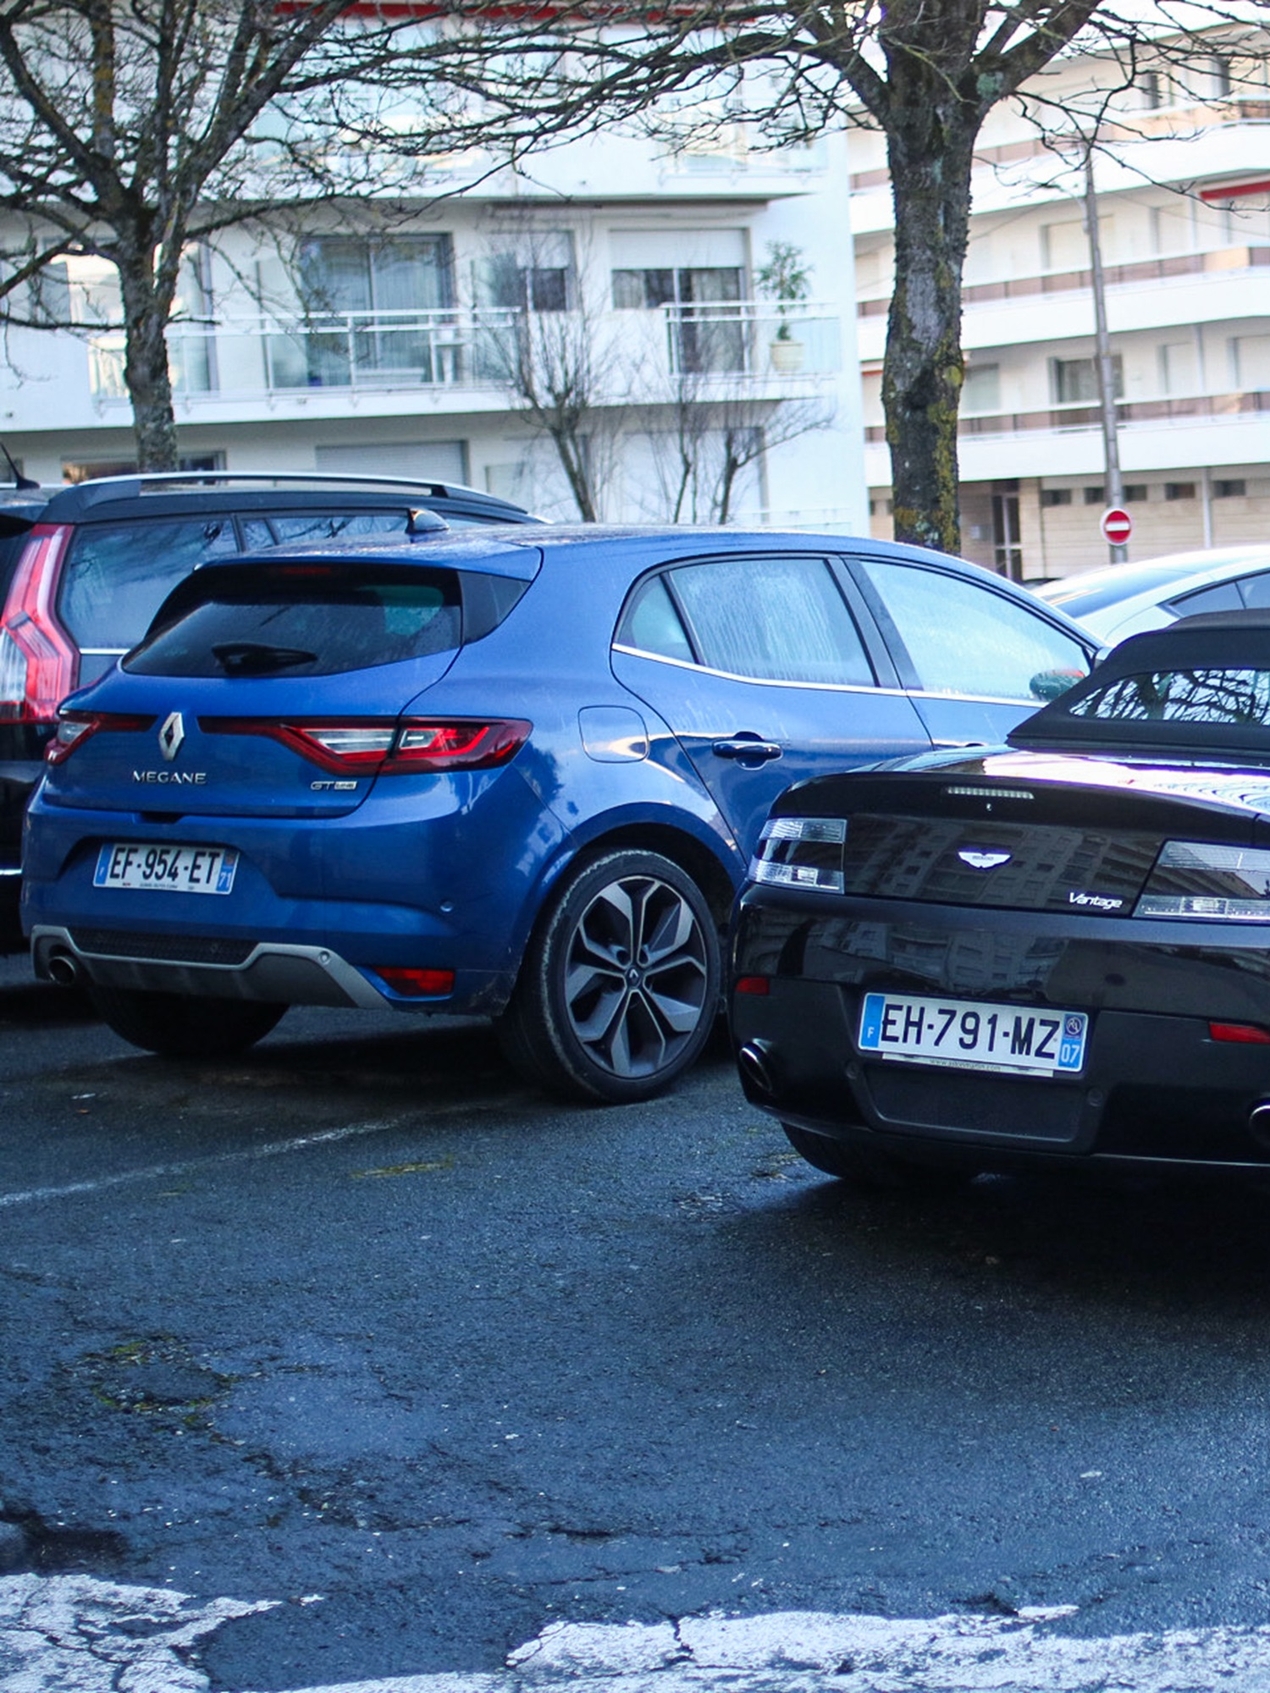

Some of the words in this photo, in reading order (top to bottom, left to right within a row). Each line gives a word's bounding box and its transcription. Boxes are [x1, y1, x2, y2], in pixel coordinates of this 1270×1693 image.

[132, 770, 206, 784] MEGANE
[311, 780, 335, 790] GT
[109, 847, 220, 884] EF-954-ET
[218, 872, 232, 888] 71
[1069, 892, 1123, 909] Vantage
[867, 1027, 875, 1039] F
[881, 1003, 1060, 1059] EH-791-MZ
[1060, 1044, 1081, 1064] 07
